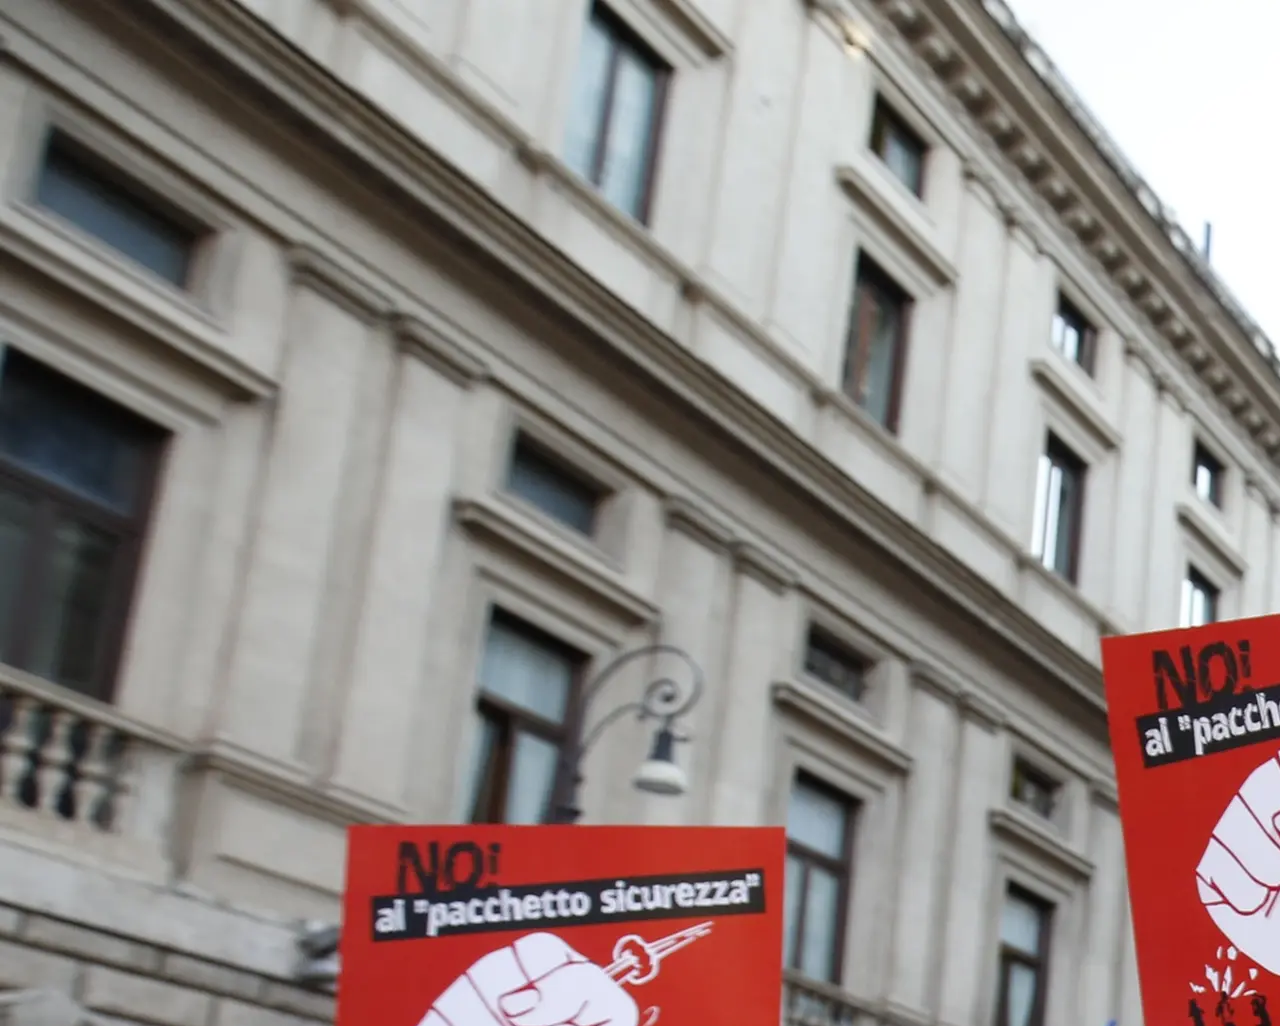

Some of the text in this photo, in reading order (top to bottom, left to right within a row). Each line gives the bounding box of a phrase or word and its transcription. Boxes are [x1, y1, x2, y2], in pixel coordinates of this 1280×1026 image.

[1144, 717, 1172, 757] al
[375, 873, 760, 937] al "pacchetto sicurezza"
